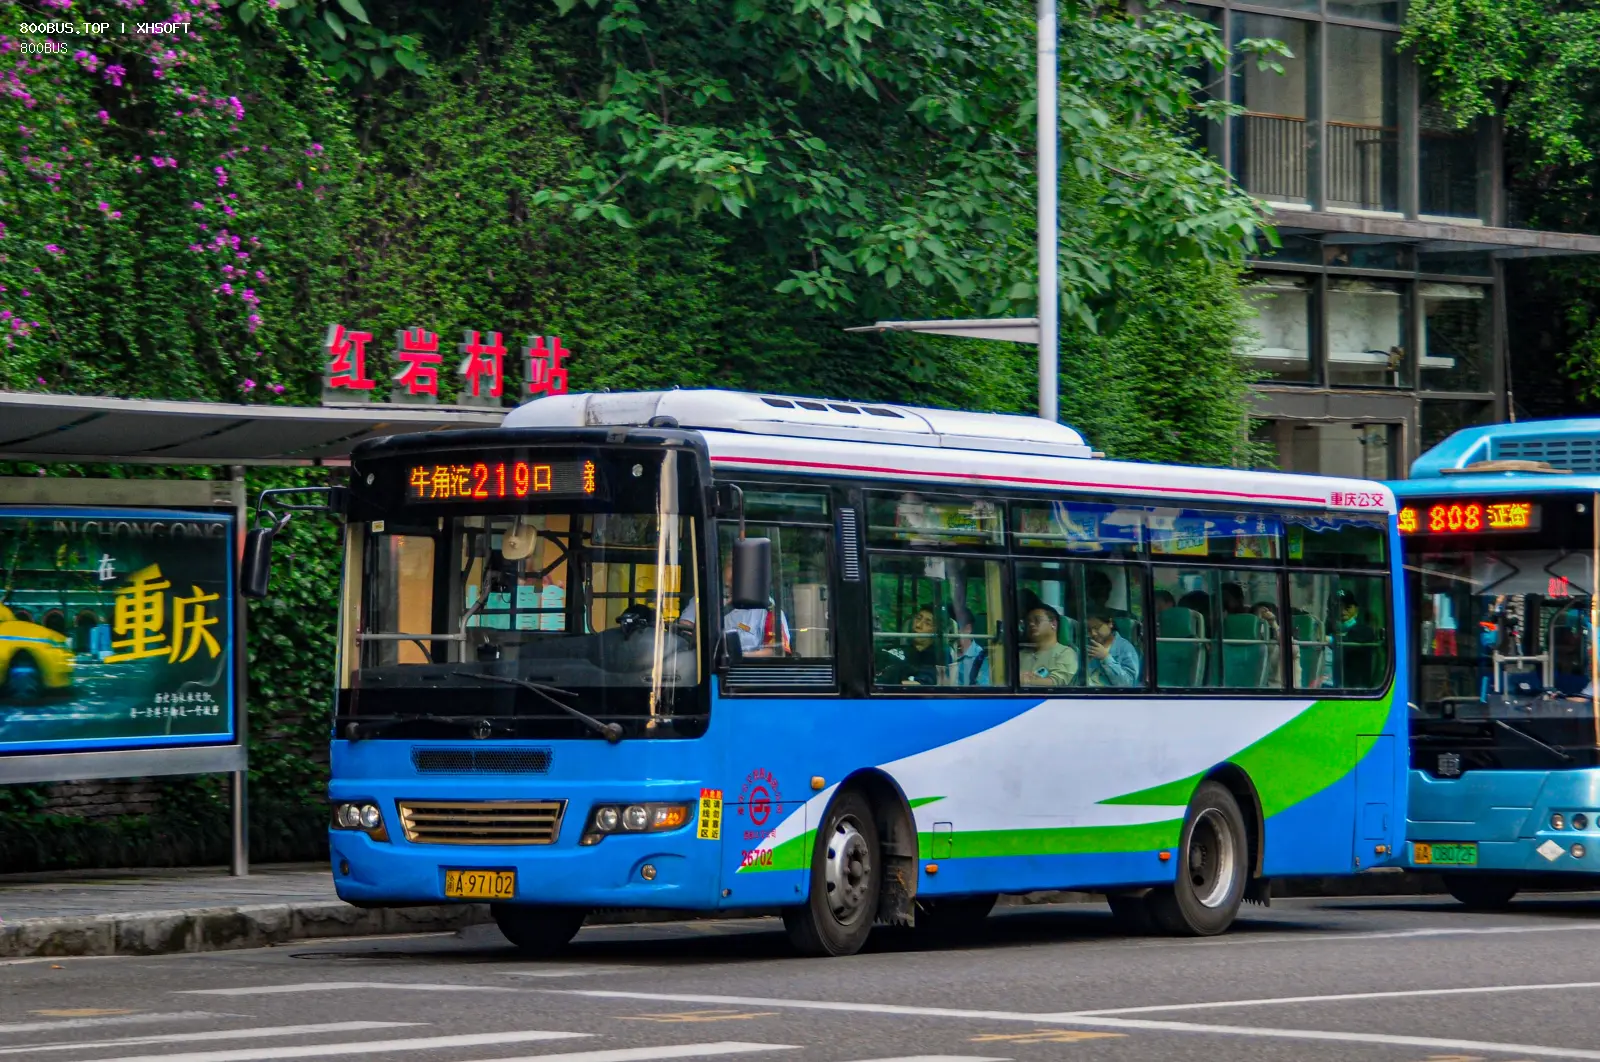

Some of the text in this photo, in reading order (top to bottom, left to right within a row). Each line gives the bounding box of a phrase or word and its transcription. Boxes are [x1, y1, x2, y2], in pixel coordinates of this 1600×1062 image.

[329, 324, 570, 397] 红岩村站
[410, 465, 471, 498] 牛角沱
[472, 462, 530, 498] 219
[1330, 492, 1384, 507] 重庆公交
[1428, 504, 1482, 531] 808
[99, 553, 222, 664] 在 重庆
[741, 848, 773, 867] 26702
